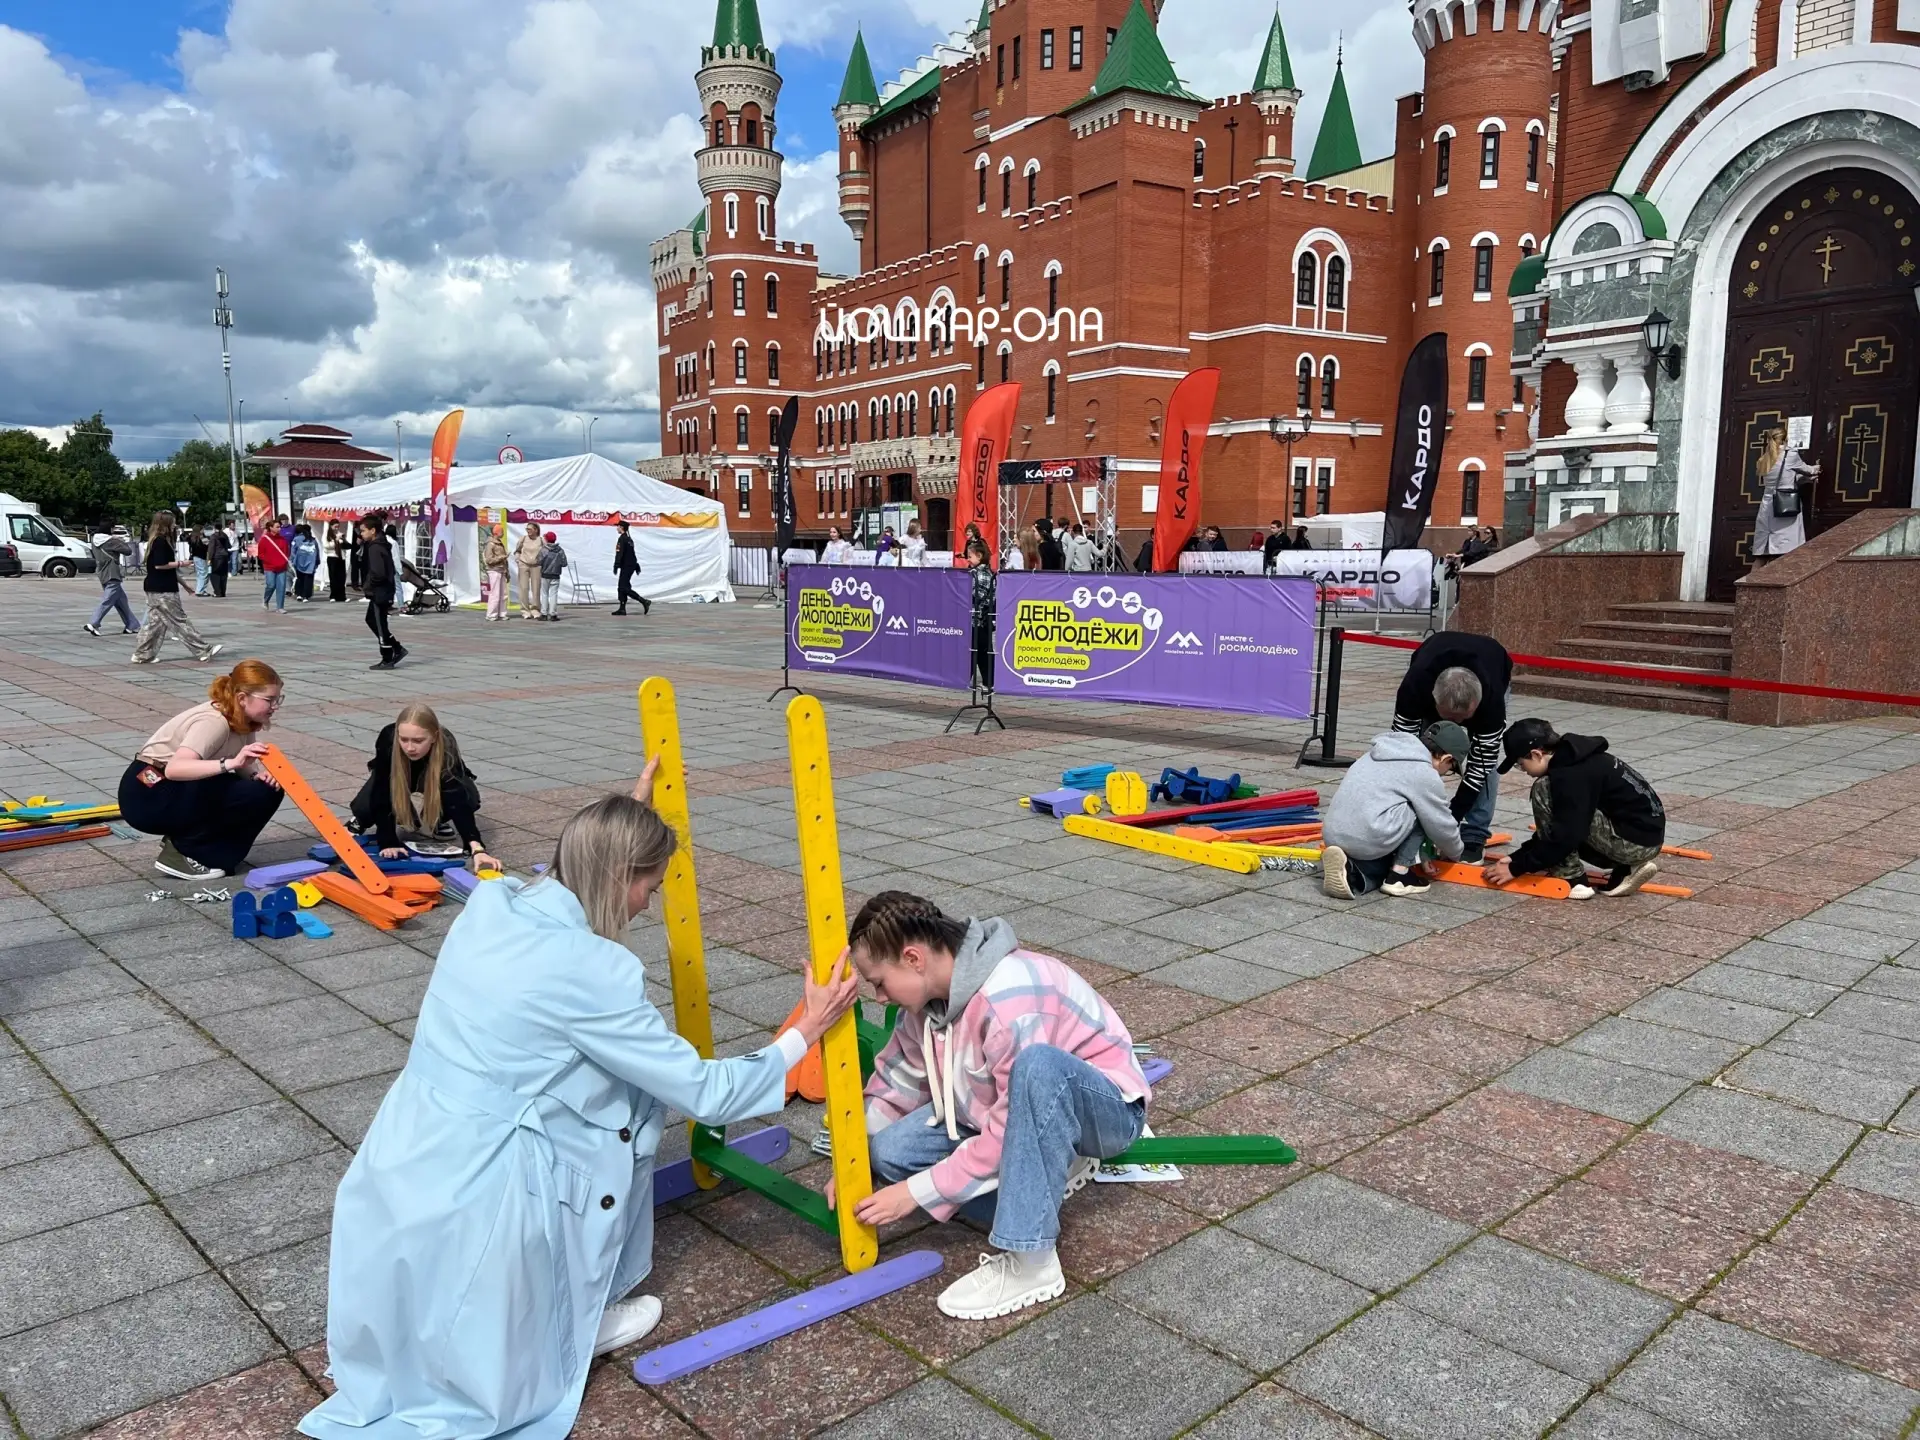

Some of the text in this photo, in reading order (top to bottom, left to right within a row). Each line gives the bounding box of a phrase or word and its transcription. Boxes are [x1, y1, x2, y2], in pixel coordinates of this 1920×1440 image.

[1401, 404, 1431, 510] КАРДО
[288, 467, 355, 479] СУВЕНИРЫ
[1025, 467, 1074, 479] КАРДО
[1174, 429, 1190, 520] КАРДО
[975, 443, 989, 519] КАРДО
[801, 592, 831, 608] ДЕНЬ
[801, 608, 871, 628] МОЛОДЁЖИ
[1019, 605, 1070, 624] ДЕНЬ
[916, 626, 963, 636] росмолодёжь
[1019, 622, 1138, 646] МОЛОДЁЖИ
[801, 635, 842, 645] росмолодёжь
[1219, 635, 1247, 643] вместе
[1018, 645, 1041, 653] проект
[1219, 643, 1299, 656] росмолодёжь
[1018, 655, 1087, 666] росмолодёжь
[1027, 675, 1072, 685] Йошкар-Ола
